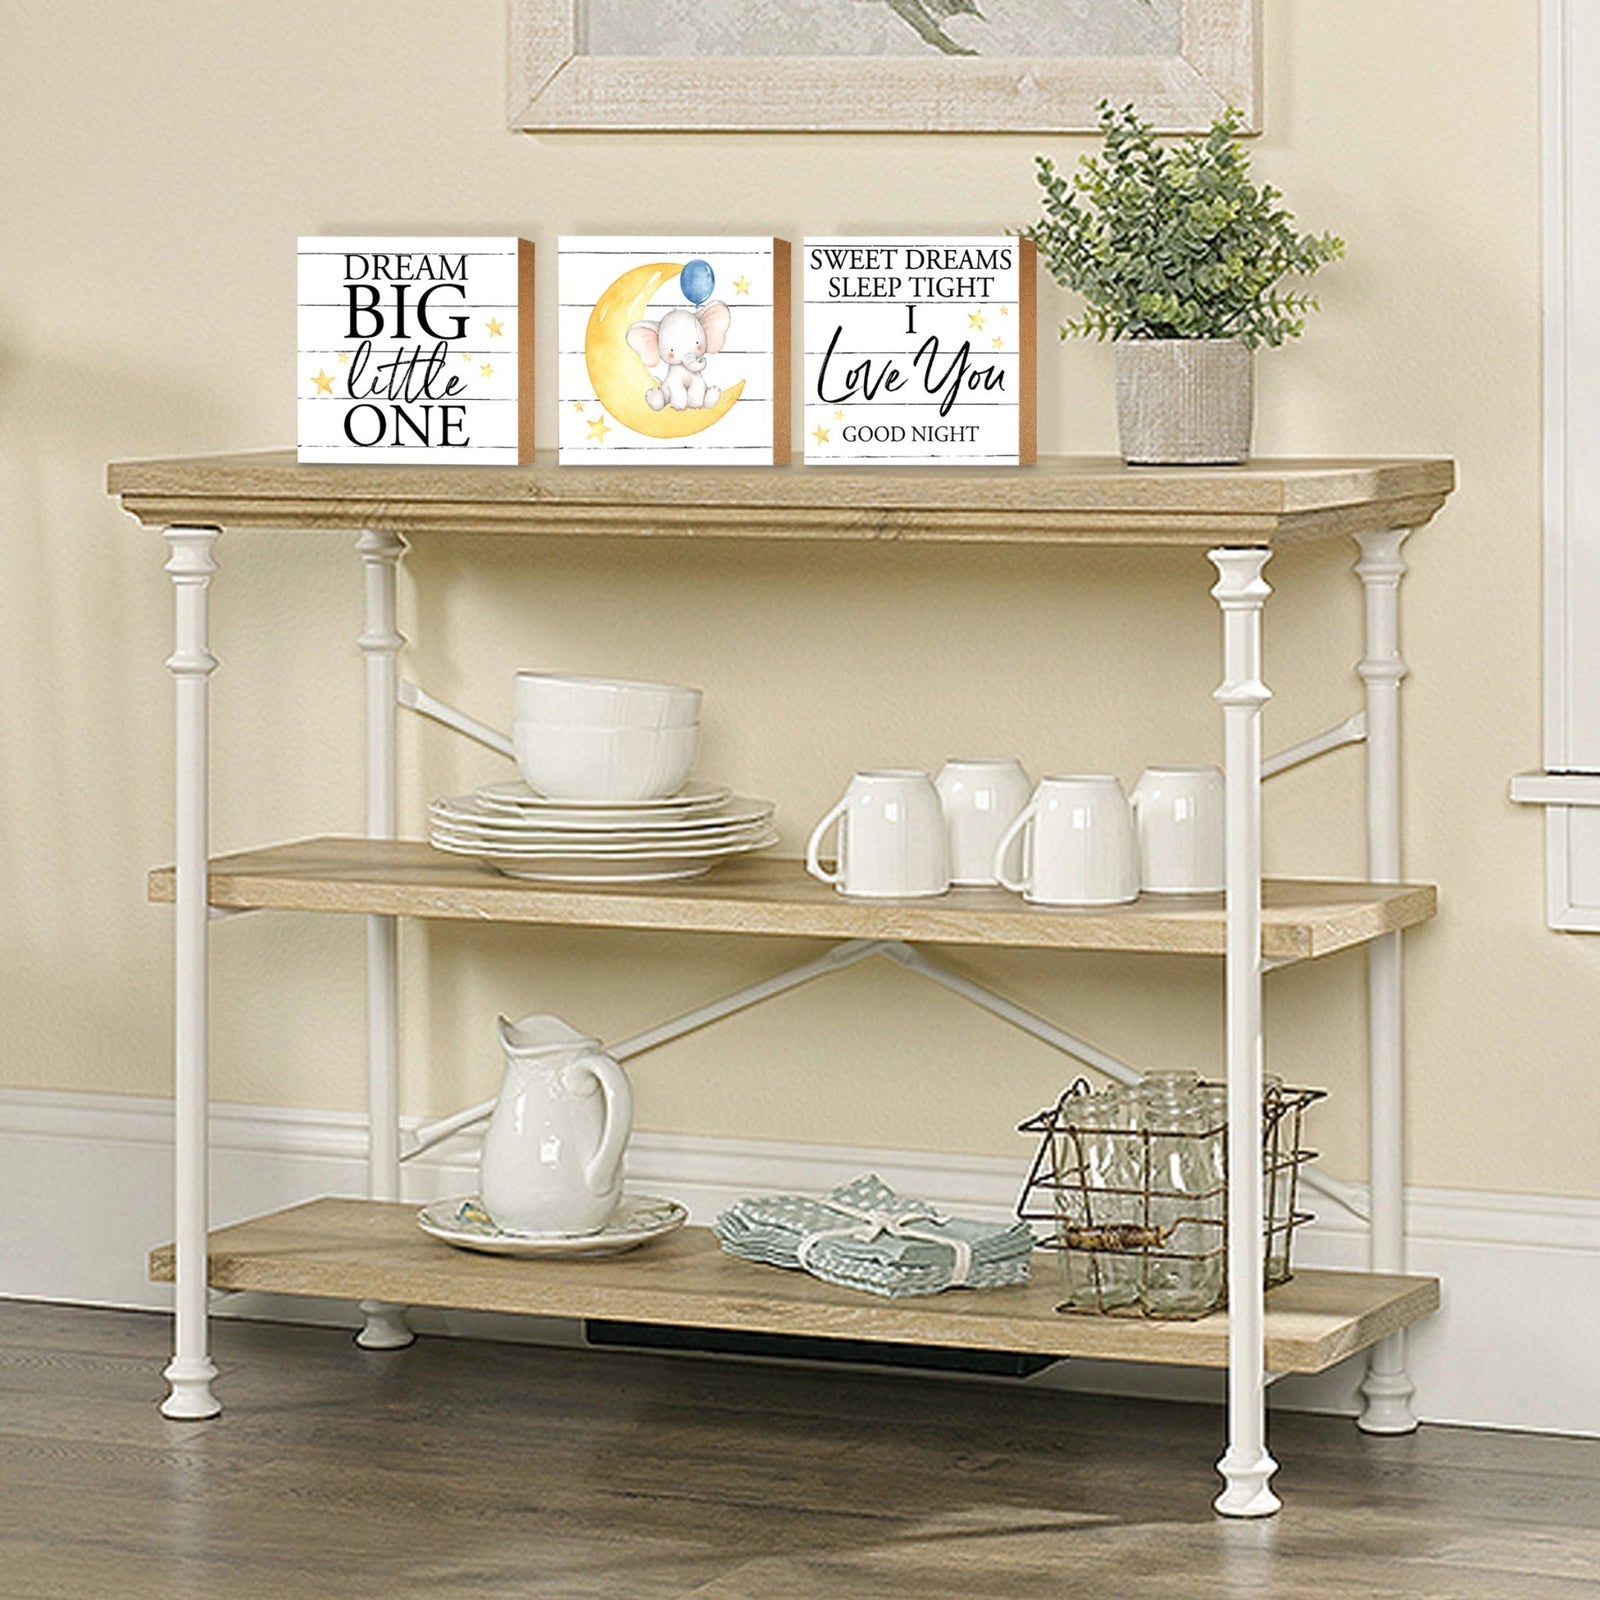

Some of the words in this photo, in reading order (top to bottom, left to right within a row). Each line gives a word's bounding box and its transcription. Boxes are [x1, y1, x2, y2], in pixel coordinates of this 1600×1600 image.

[344, 254, 468, 280] DREAM
[810, 248, 898, 270] SWEET
[905, 248, 1012, 270] DREAMS
[828, 276, 902, 298] SLEEP
[908, 276, 995, 298] TIGHT
[343, 283, 470, 340] BIG
[905, 305, 917, 334] I
[348, 340, 468, 403] little
[817, 325, 908, 404] Love
[913, 335, 1005, 417] You
[343, 404, 470, 447] ONE
[842, 425, 906, 442] GOOD
[911, 425, 980, 442] NIGHT
